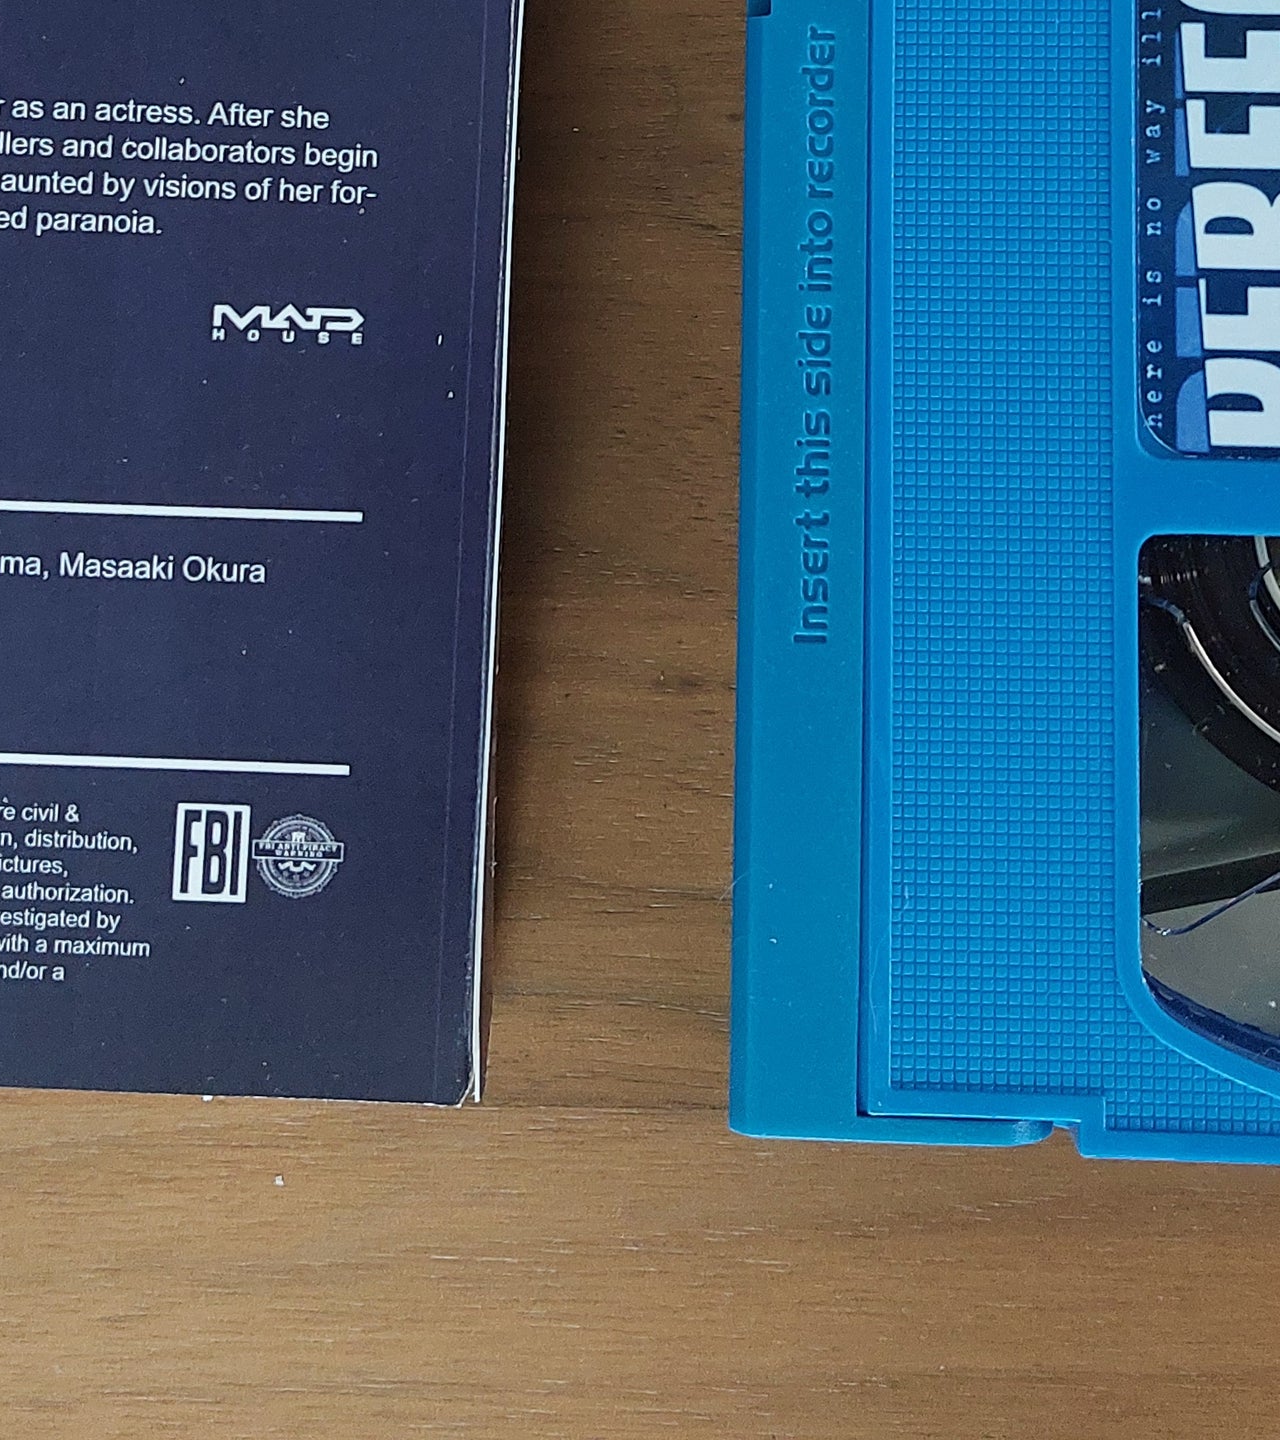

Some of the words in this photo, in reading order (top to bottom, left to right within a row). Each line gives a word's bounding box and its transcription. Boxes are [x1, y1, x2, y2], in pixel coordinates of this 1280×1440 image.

[10, 99, 44, 119] as
[51, 100, 86, 120] an
[93, 99, 200, 125] actress.
[206, 101, 274, 127] After
[279, 104, 330, 129] she
[799, 21, 836, 199] recorder
[1145, 97, 1166, 162] way
[61, 134, 113, 158] and
[120, 135, 295, 164] collaborators
[303, 141, 378, 173] begin
[101, 171, 135, 202] by
[142, 172, 236, 199] visions
[243, 176, 272, 200] of
[278, 177, 324, 202] her
[330, 179, 377, 205] for-
[35, 208, 161, 236] paranoia.
[1145, 196, 1163, 235] no
[796, 208, 834, 292] into
[1142, 268, 1162, 305] is
[212, 328, 363, 345] HOUSE
[796, 305, 832, 396] side
[793, 409, 833, 497] this
[58, 551, 173, 580] Masaaki
[182, 555, 266, 583] Okura
[791, 509, 831, 644] Insert
[20, 802, 59, 821] civil
[63, 803, 79, 822] &
[23, 828, 137, 854] distribution,
[180, 809, 243, 896] FBI
[0, 880, 134, 904] authorization.
[95, 909, 121, 934] by
